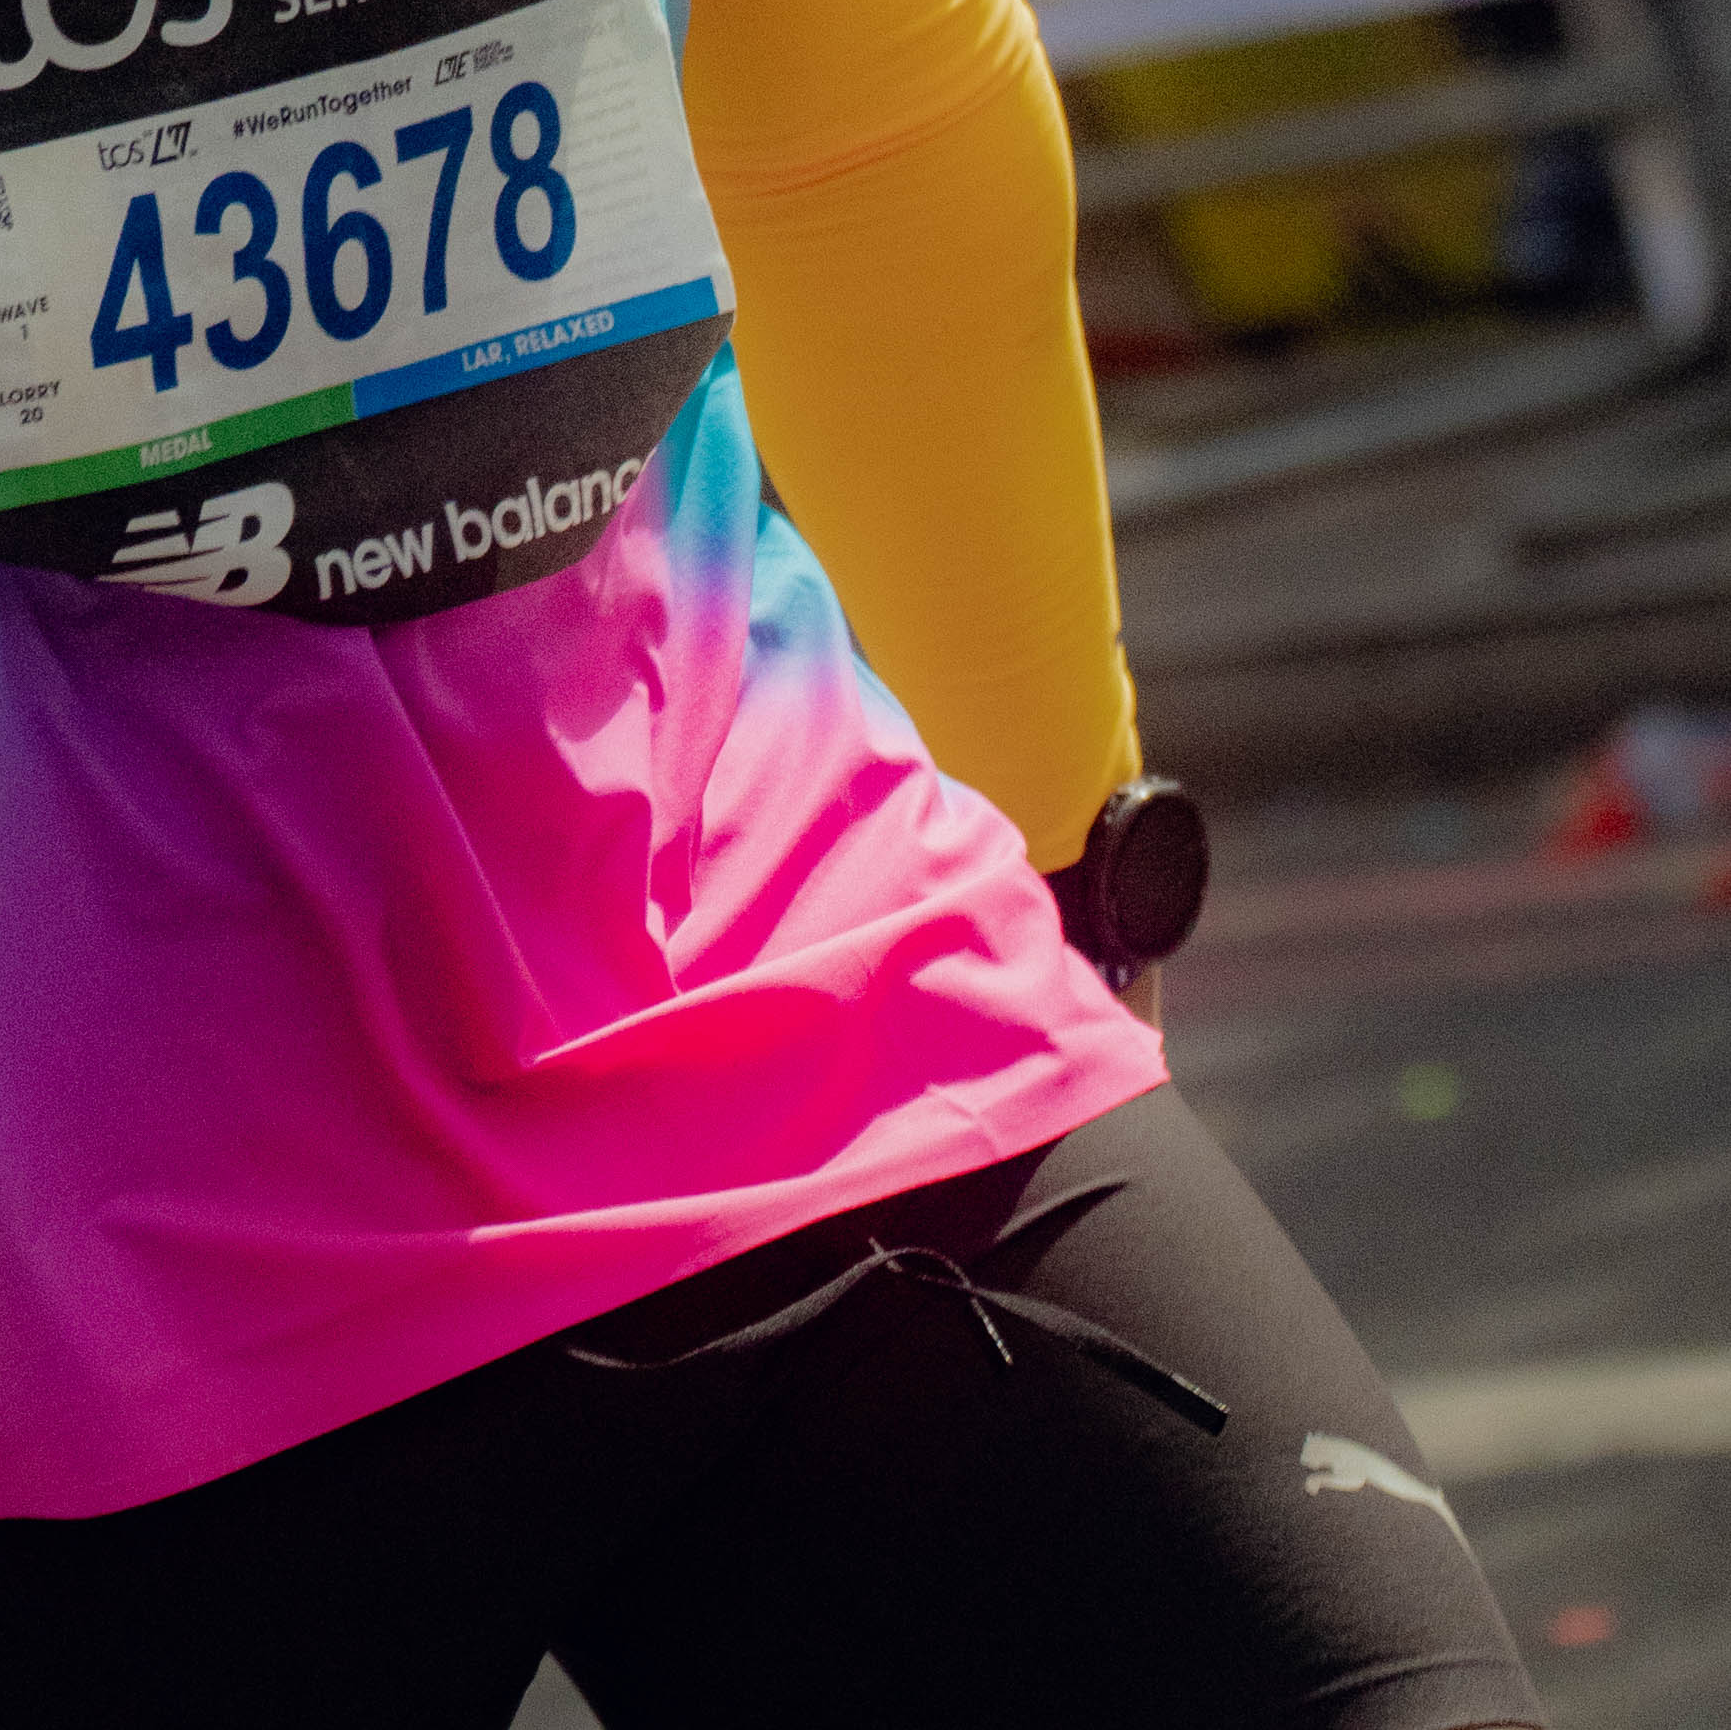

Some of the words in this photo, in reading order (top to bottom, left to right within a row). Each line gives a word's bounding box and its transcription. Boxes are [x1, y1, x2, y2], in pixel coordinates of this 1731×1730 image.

[232, 75, 413, 139] #WeRunTogether
[90, 81, 578, 394] 43678
[461, 339, 513, 374] LAR,
[515, 309, 615, 358] RELAXED
[0, 379, 61, 407] LORRY
[20, 406, 44, 425] 20
[138, 428, 213, 470] MEDAL
[314, 521, 434, 602] new
[444, 457, 658, 564] balanc
